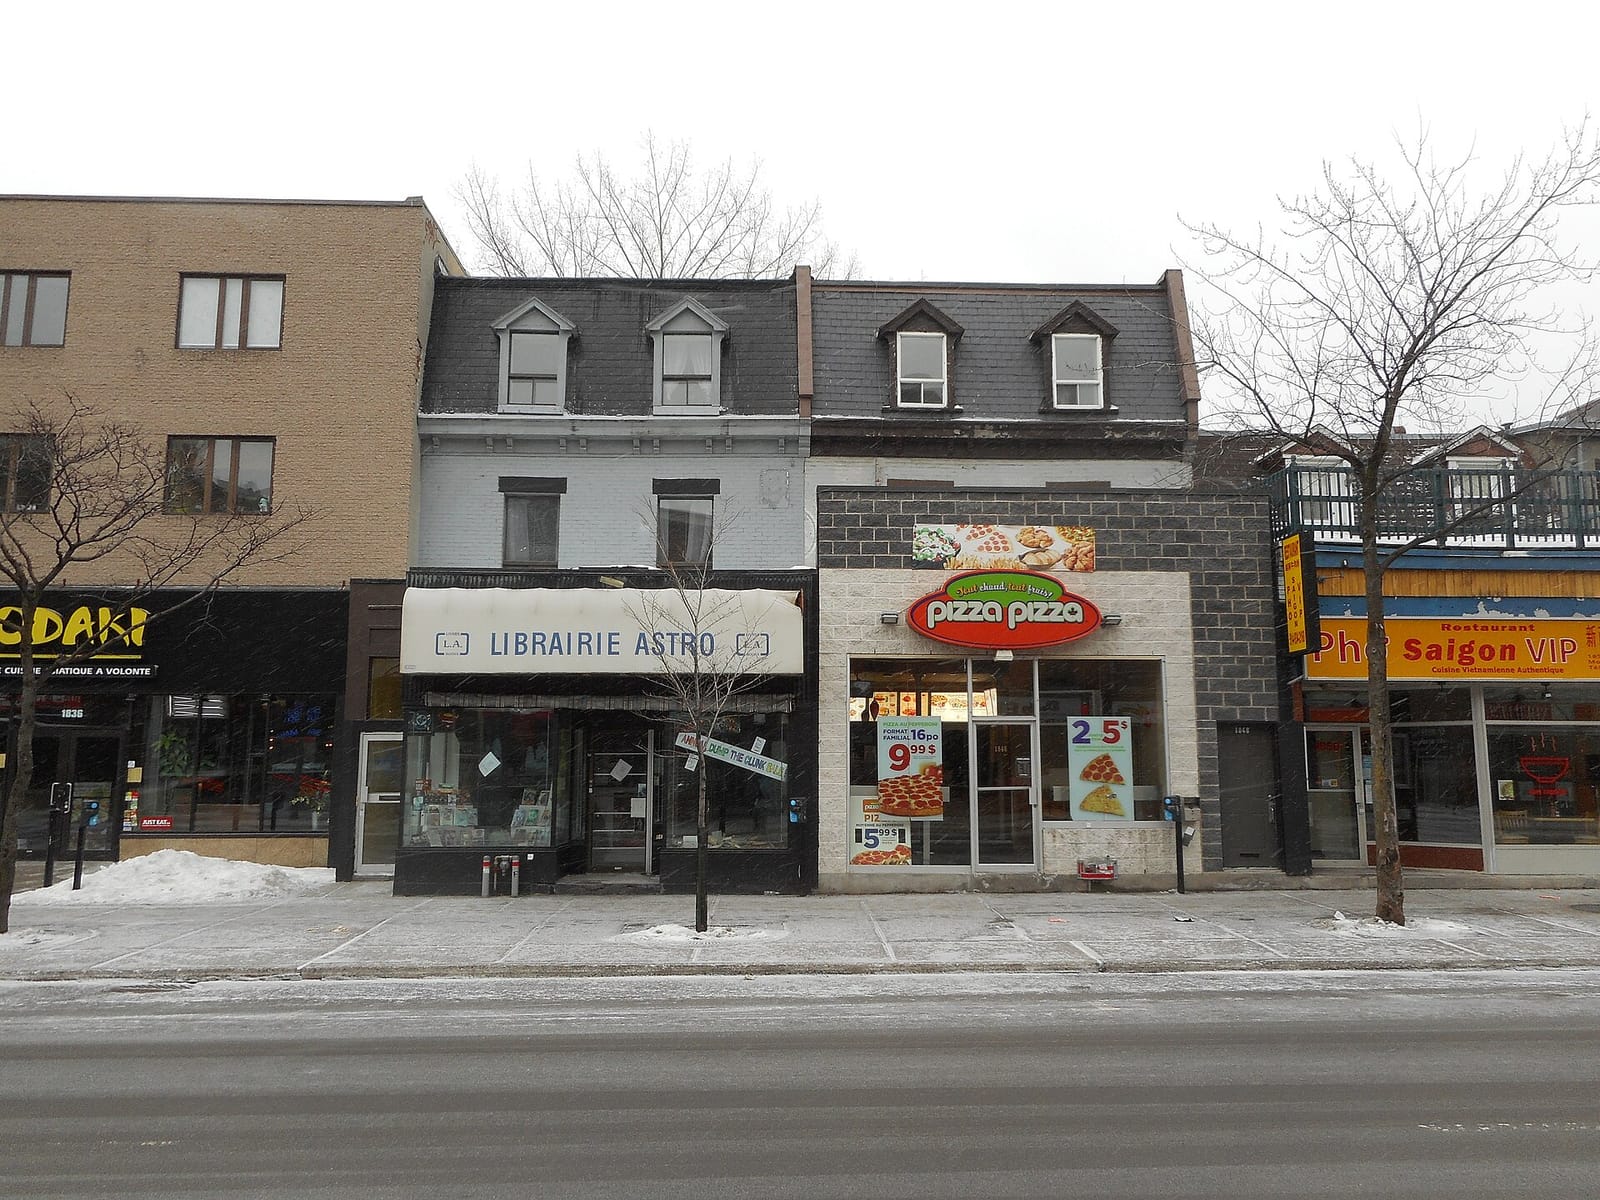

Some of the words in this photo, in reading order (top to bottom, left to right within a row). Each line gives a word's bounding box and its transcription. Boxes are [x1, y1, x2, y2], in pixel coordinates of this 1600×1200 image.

[956, 583, 977, 597] Tout
[979, 581, 1008, 592] chaud,
[1008, 582, 1026, 592] tout
[1027, 584, 1053, 599] frais!
[926, 600, 1003, 630] pizza
[1007, 600, 1084, 630] pizza
[1440, 623, 1536, 632] Restaurant
[491, 632, 620, 656] LIBRAIRIE
[634, 632, 715, 657] ASTRO
[1313, 630, 1390, 663] Ph
[1403, 637, 1517, 666] Saigon
[1524, 637, 1578, 663] VIP
[95, 667, 104, 675] A
[106, 667, 151, 676] VOLONTE
[1517, 666, 1564, 674] Authentique
[1072, 720, 1091, 744] 2
[708, 743, 729, 757] DUMP
[729, 750, 745, 762] THE
